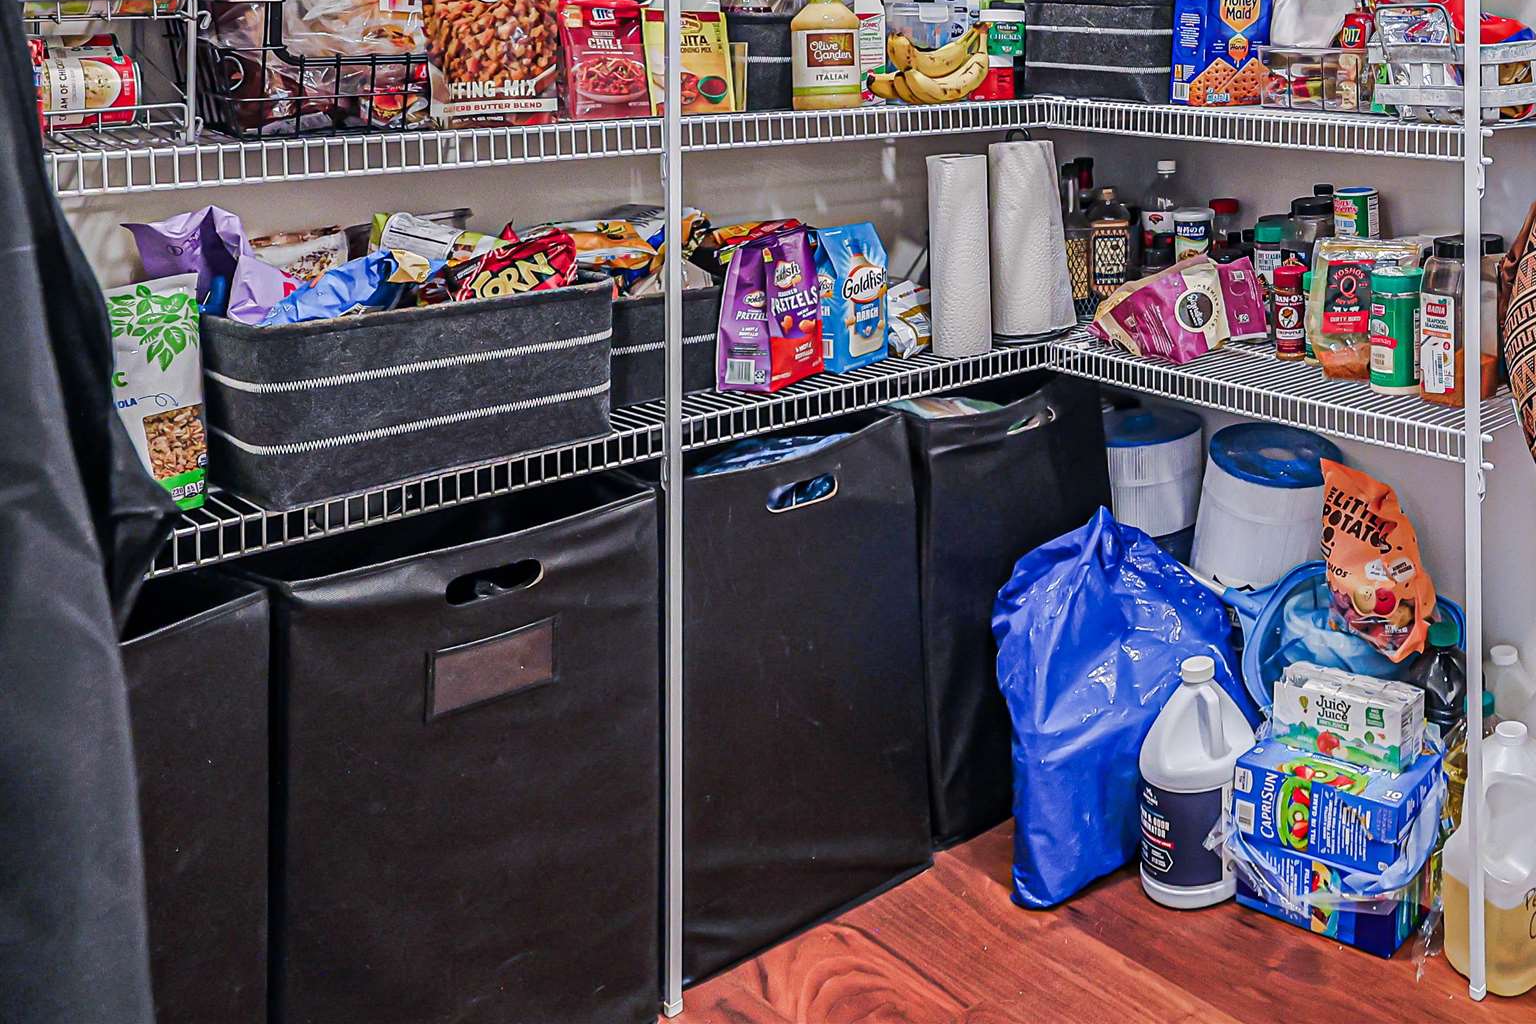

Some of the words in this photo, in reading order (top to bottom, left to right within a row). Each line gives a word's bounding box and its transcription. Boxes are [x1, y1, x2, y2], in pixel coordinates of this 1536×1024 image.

[1226, 6, 1252, 21] Maid
[680, 35, 710, 47] JITA
[1343, 28, 1360, 43] RITZ
[587, 37, 623, 50] CHILI
[809, 40, 839, 53] Olive
[813, 48, 852, 61] Garden
[815, 73, 849, 81] ITALIAN
[59, 83, 69, 95] OF
[504, 79, 537, 97] MIX
[58, 99, 69, 122] CAM
[474, 103, 511, 112] BUTTER
[513, 101, 542, 110] BLEND
[1334, 267, 1365, 280] KOSMOS
[842, 267, 887, 299] Goldfish
[1339, 275, 1357, 299] Q
[771, 286, 818, 317] PRETZELS
[1275, 294, 1304, 303] DAN-O'S
[1427, 306, 1446, 315] BADIA
[1326, 486, 1338, 502] THE
[1316, 695, 1351, 714] Juicy
[1318, 707, 1348, 722] Juice
[1385, 790, 1403, 799] 10
[1312, 793, 1320, 816] GAME
